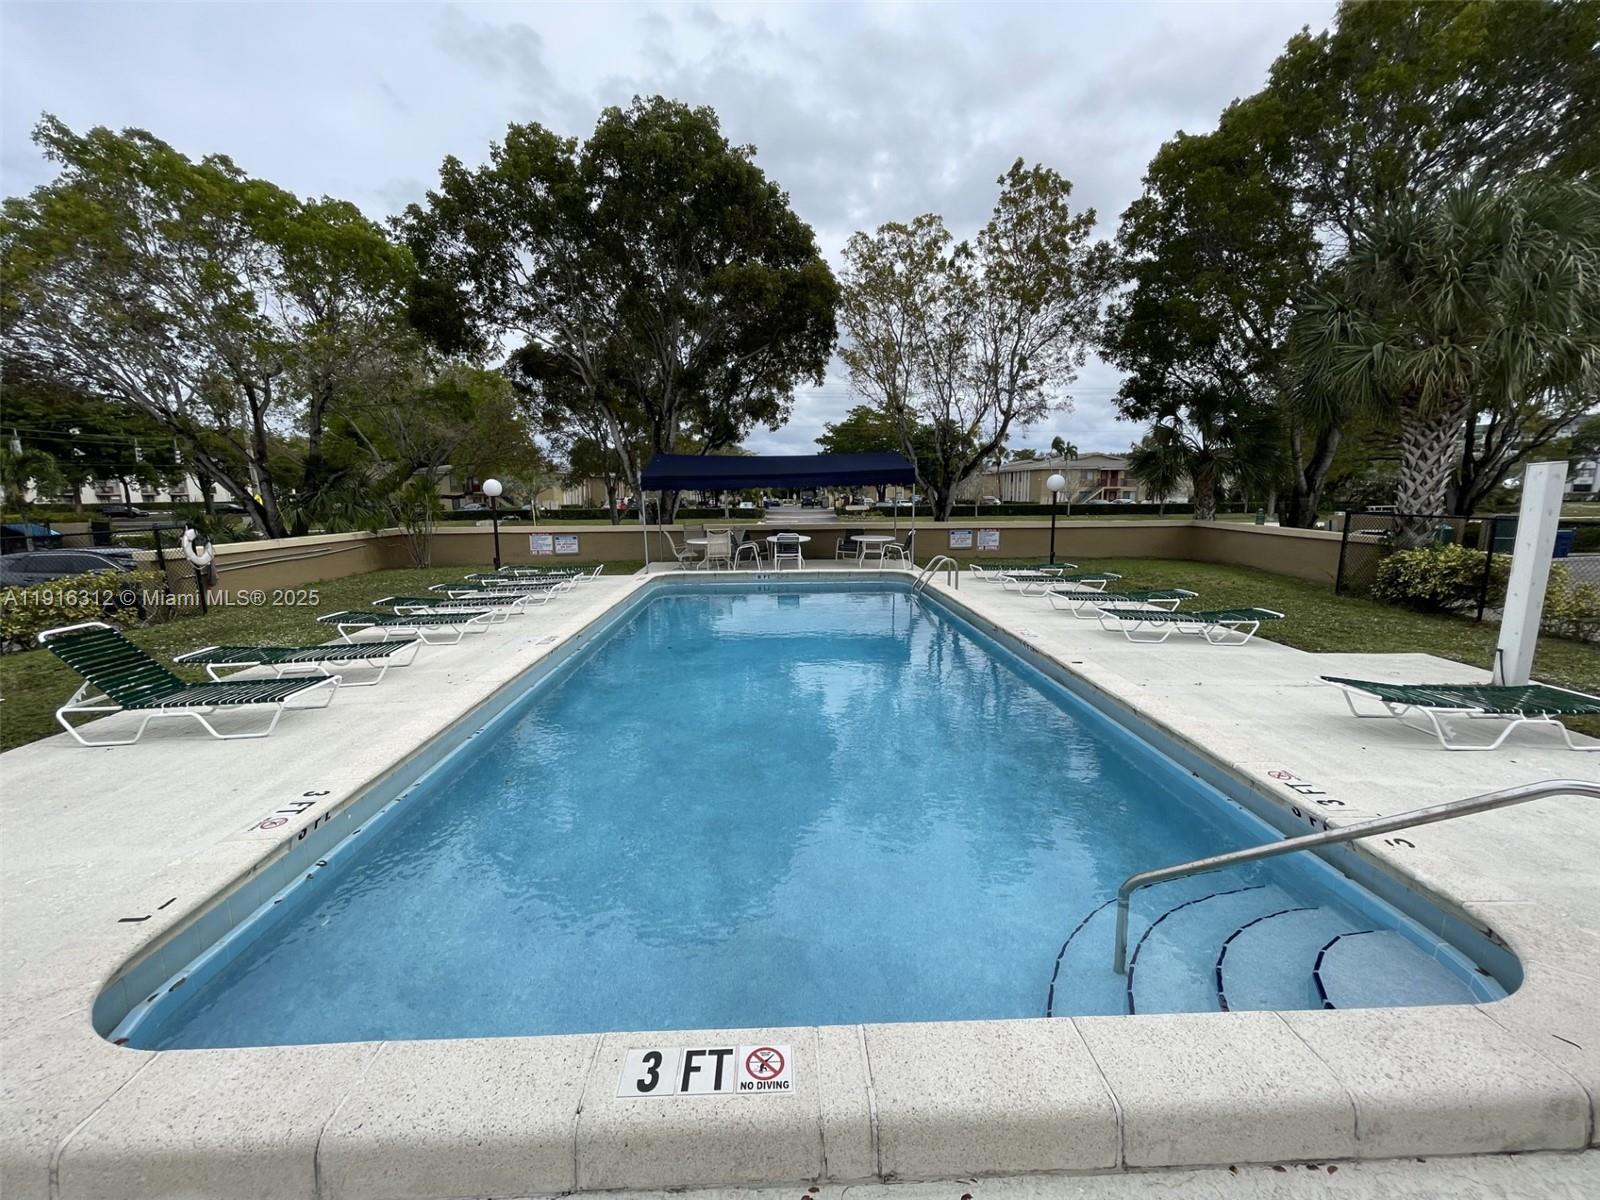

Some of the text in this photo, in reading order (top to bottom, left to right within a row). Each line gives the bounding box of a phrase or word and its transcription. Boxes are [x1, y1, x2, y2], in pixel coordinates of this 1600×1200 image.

[1284, 782, 1327, 794] FT
[276, 801, 316, 815] FT
[636, 1049, 733, 1093] 3 FT
[740, 1080, 790, 1090] NO DIVING
